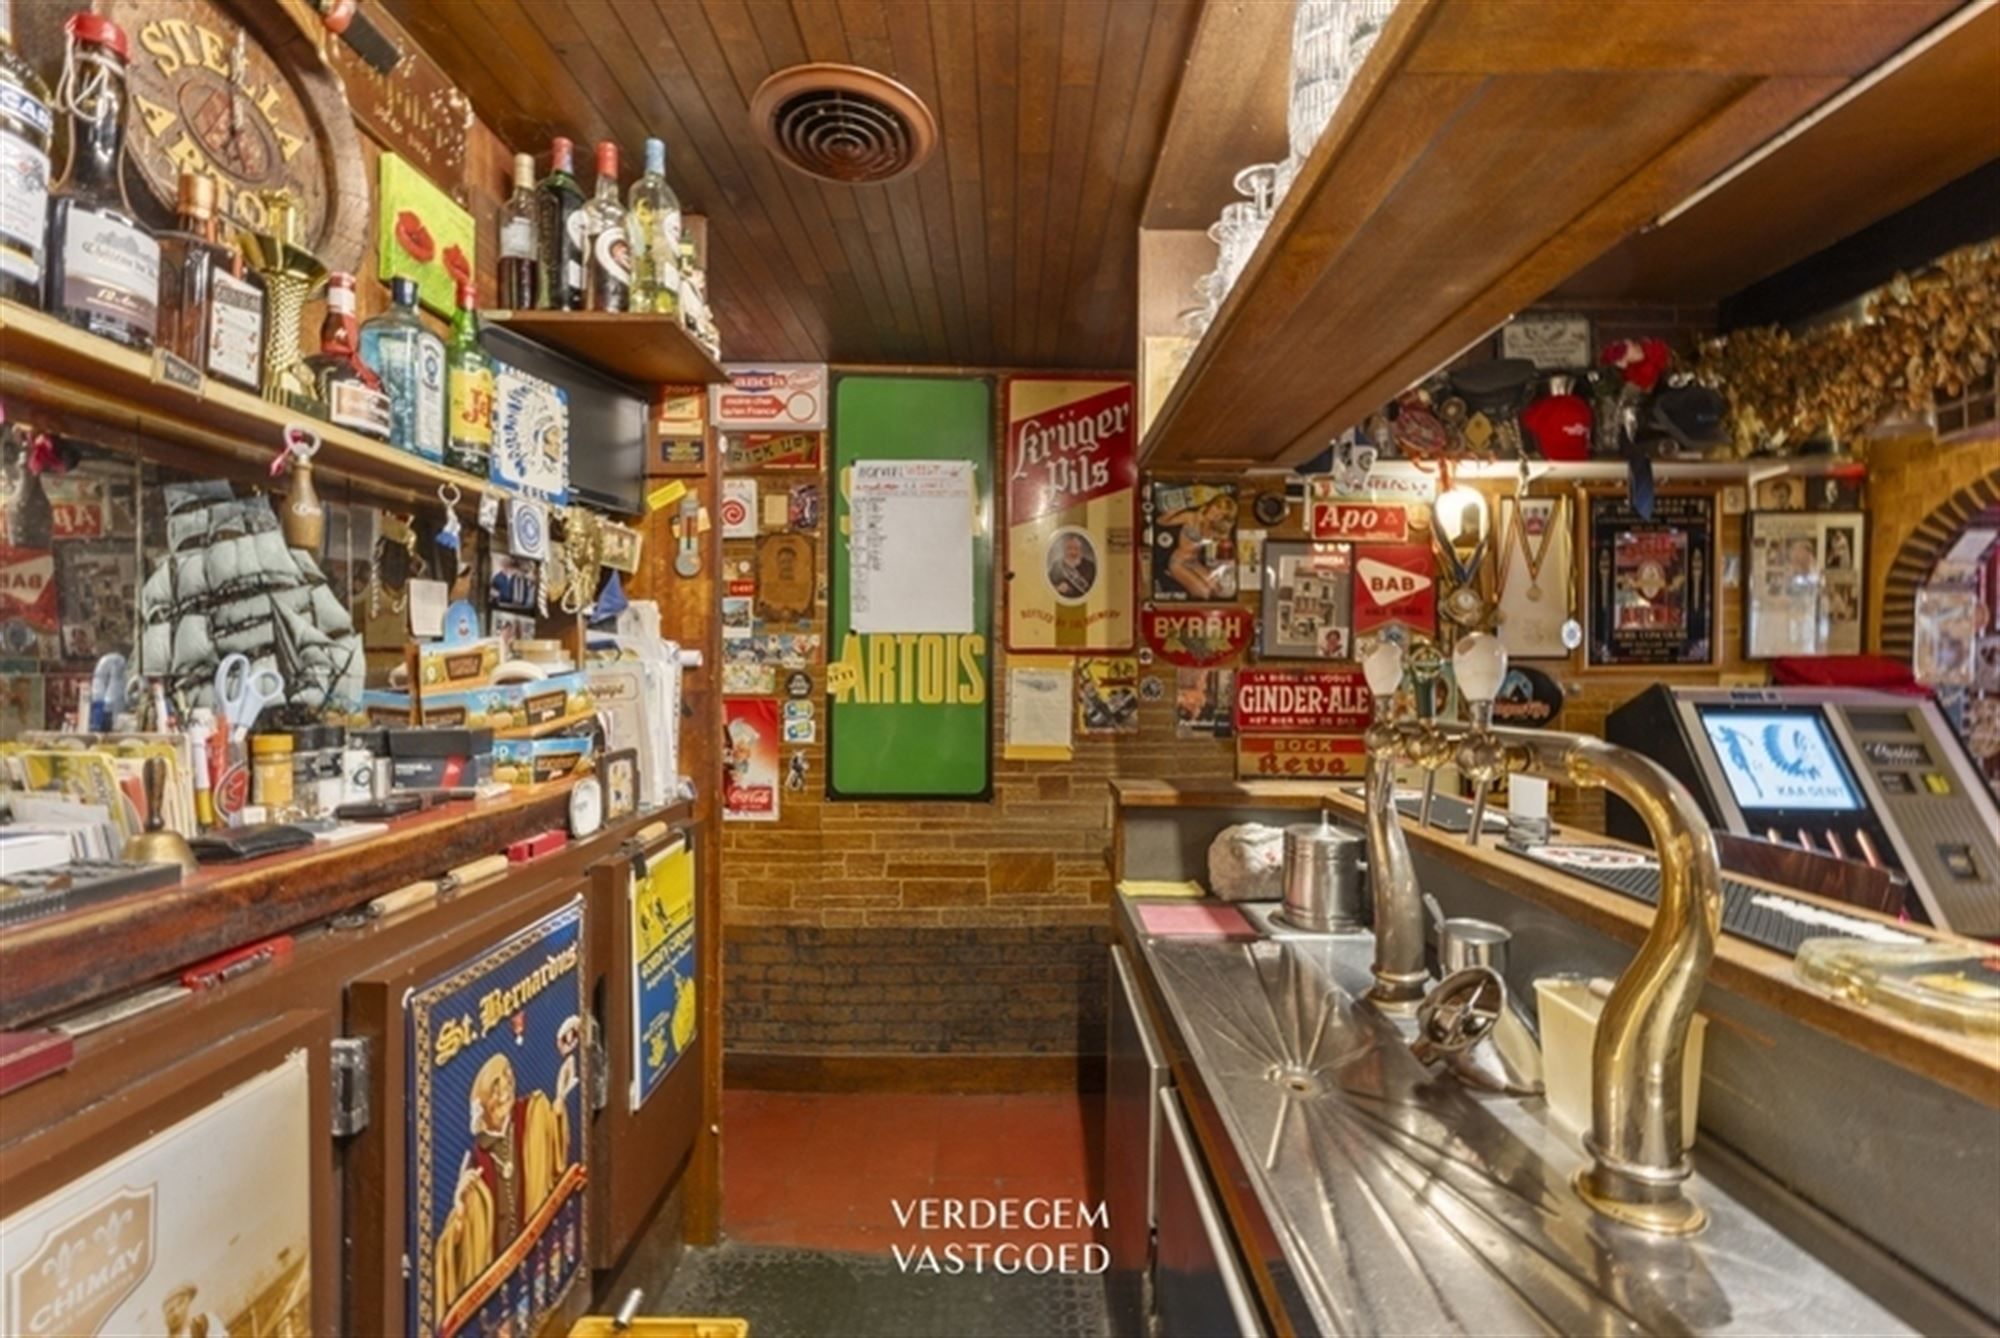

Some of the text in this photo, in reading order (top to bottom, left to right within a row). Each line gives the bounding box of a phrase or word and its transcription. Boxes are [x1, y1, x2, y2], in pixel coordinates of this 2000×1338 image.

[1011, 403, 1129, 480] Krüger
[1045, 453, 1111, 508] Pils
[1318, 505, 1378, 534] Apo
[1371, 577, 1415, 591] BAB
[1154, 616, 1242, 639] BYRRH
[835, 634, 986, 705] ARTOIS
[1273, 739, 1332, 751] BOCK
[435, 1013, 478, 1067] St.
[480, 942, 578, 1039] Bernardus
[29, 1240, 144, 1334] CHIMAY
